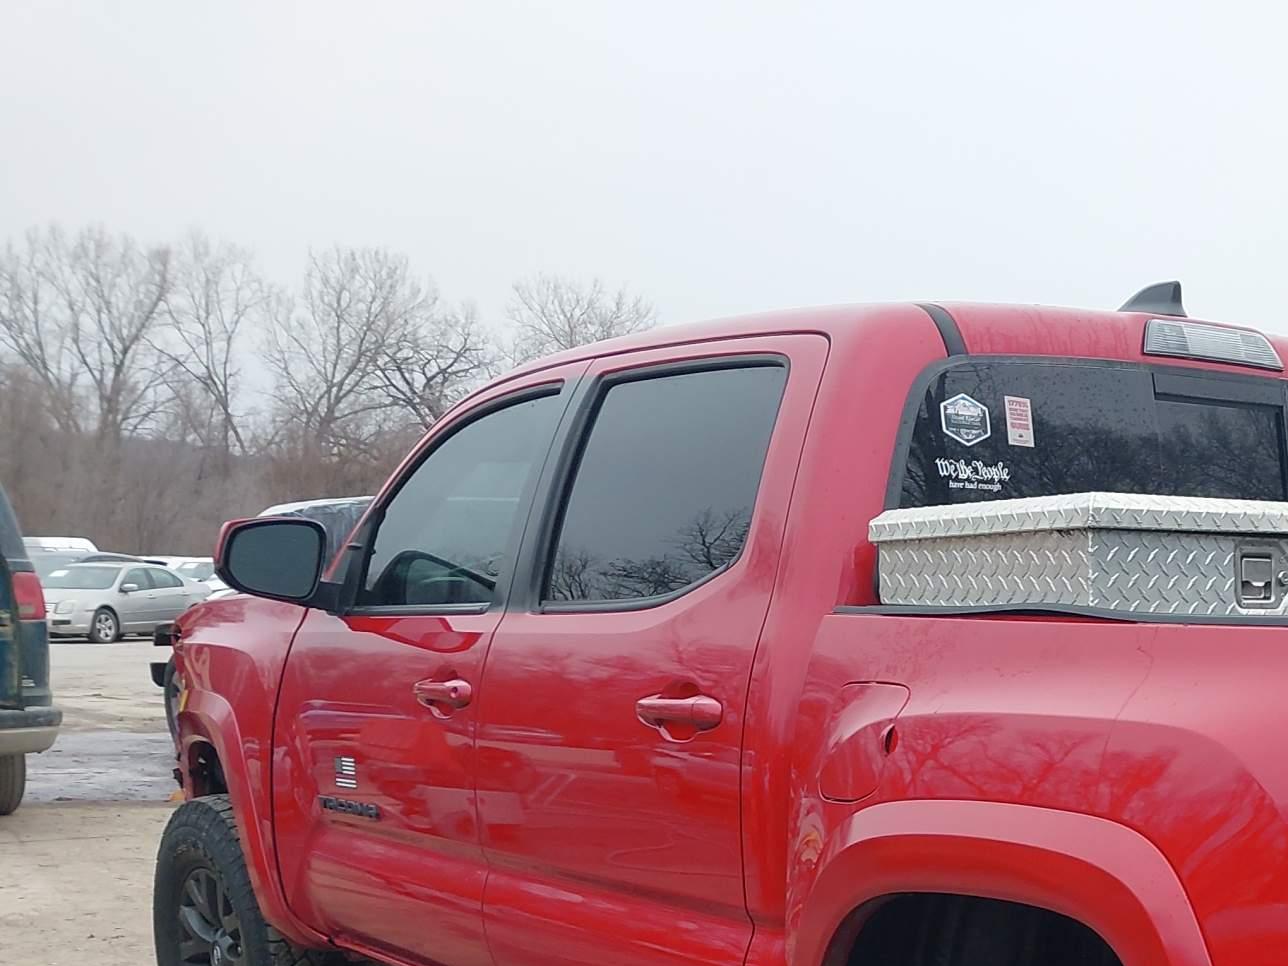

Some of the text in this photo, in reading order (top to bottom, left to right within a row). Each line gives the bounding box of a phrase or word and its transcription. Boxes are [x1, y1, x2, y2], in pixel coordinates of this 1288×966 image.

[935, 458, 957, 479] We
[971, 460, 1010, 484] People
[949, 480, 1002, 492] have had enough
